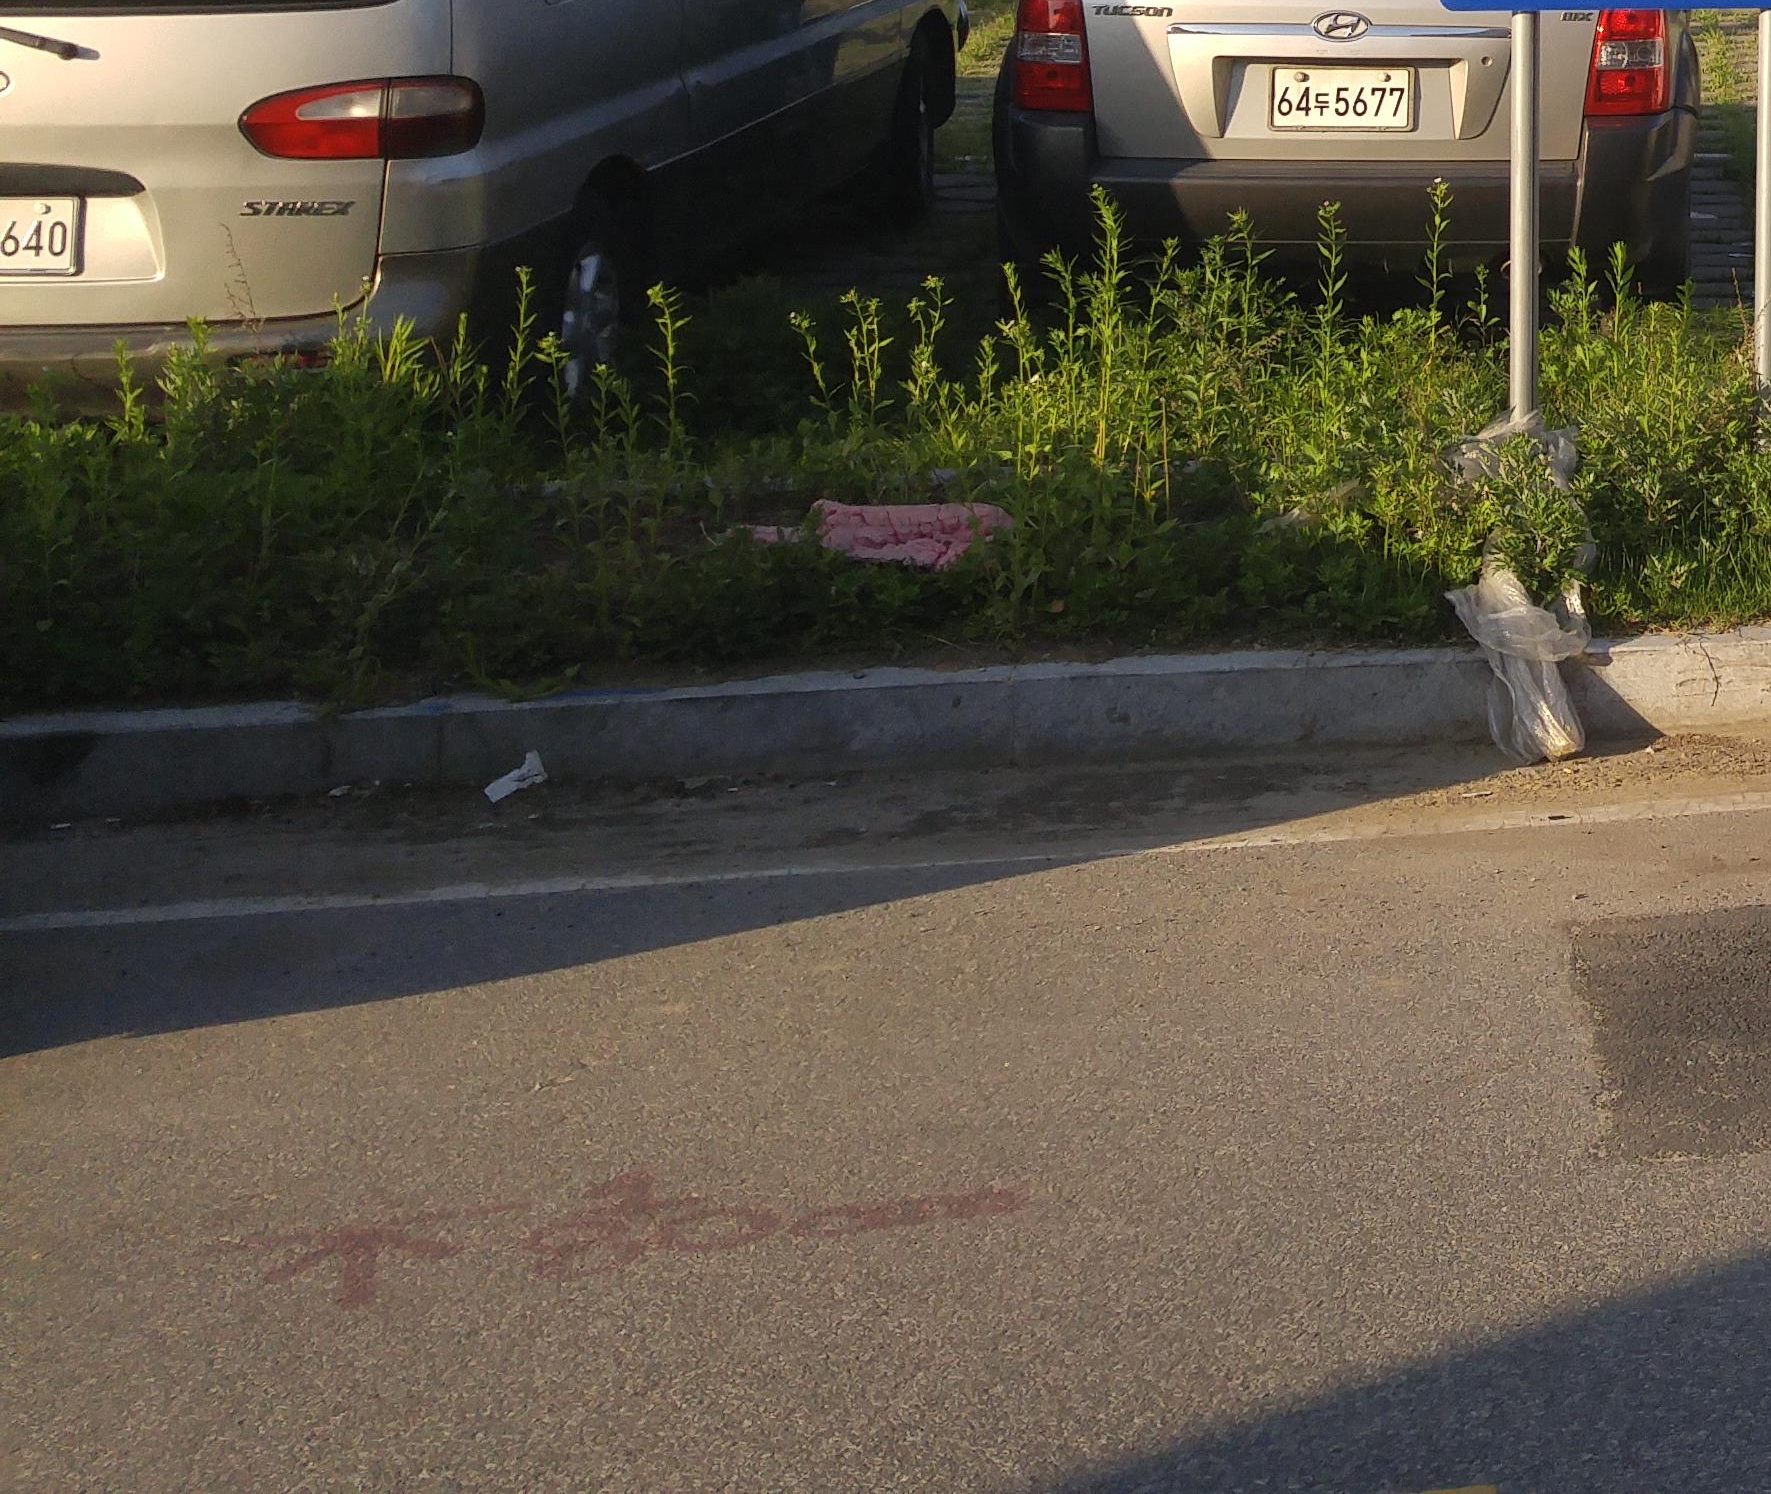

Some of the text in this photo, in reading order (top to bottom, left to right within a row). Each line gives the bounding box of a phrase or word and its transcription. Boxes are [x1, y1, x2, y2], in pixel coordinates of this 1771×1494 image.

[1092, 4, 1173, 17] TUCSON
[1276, 86, 1406, 117] 64두5677
[240, 201, 356, 217] STAREX
